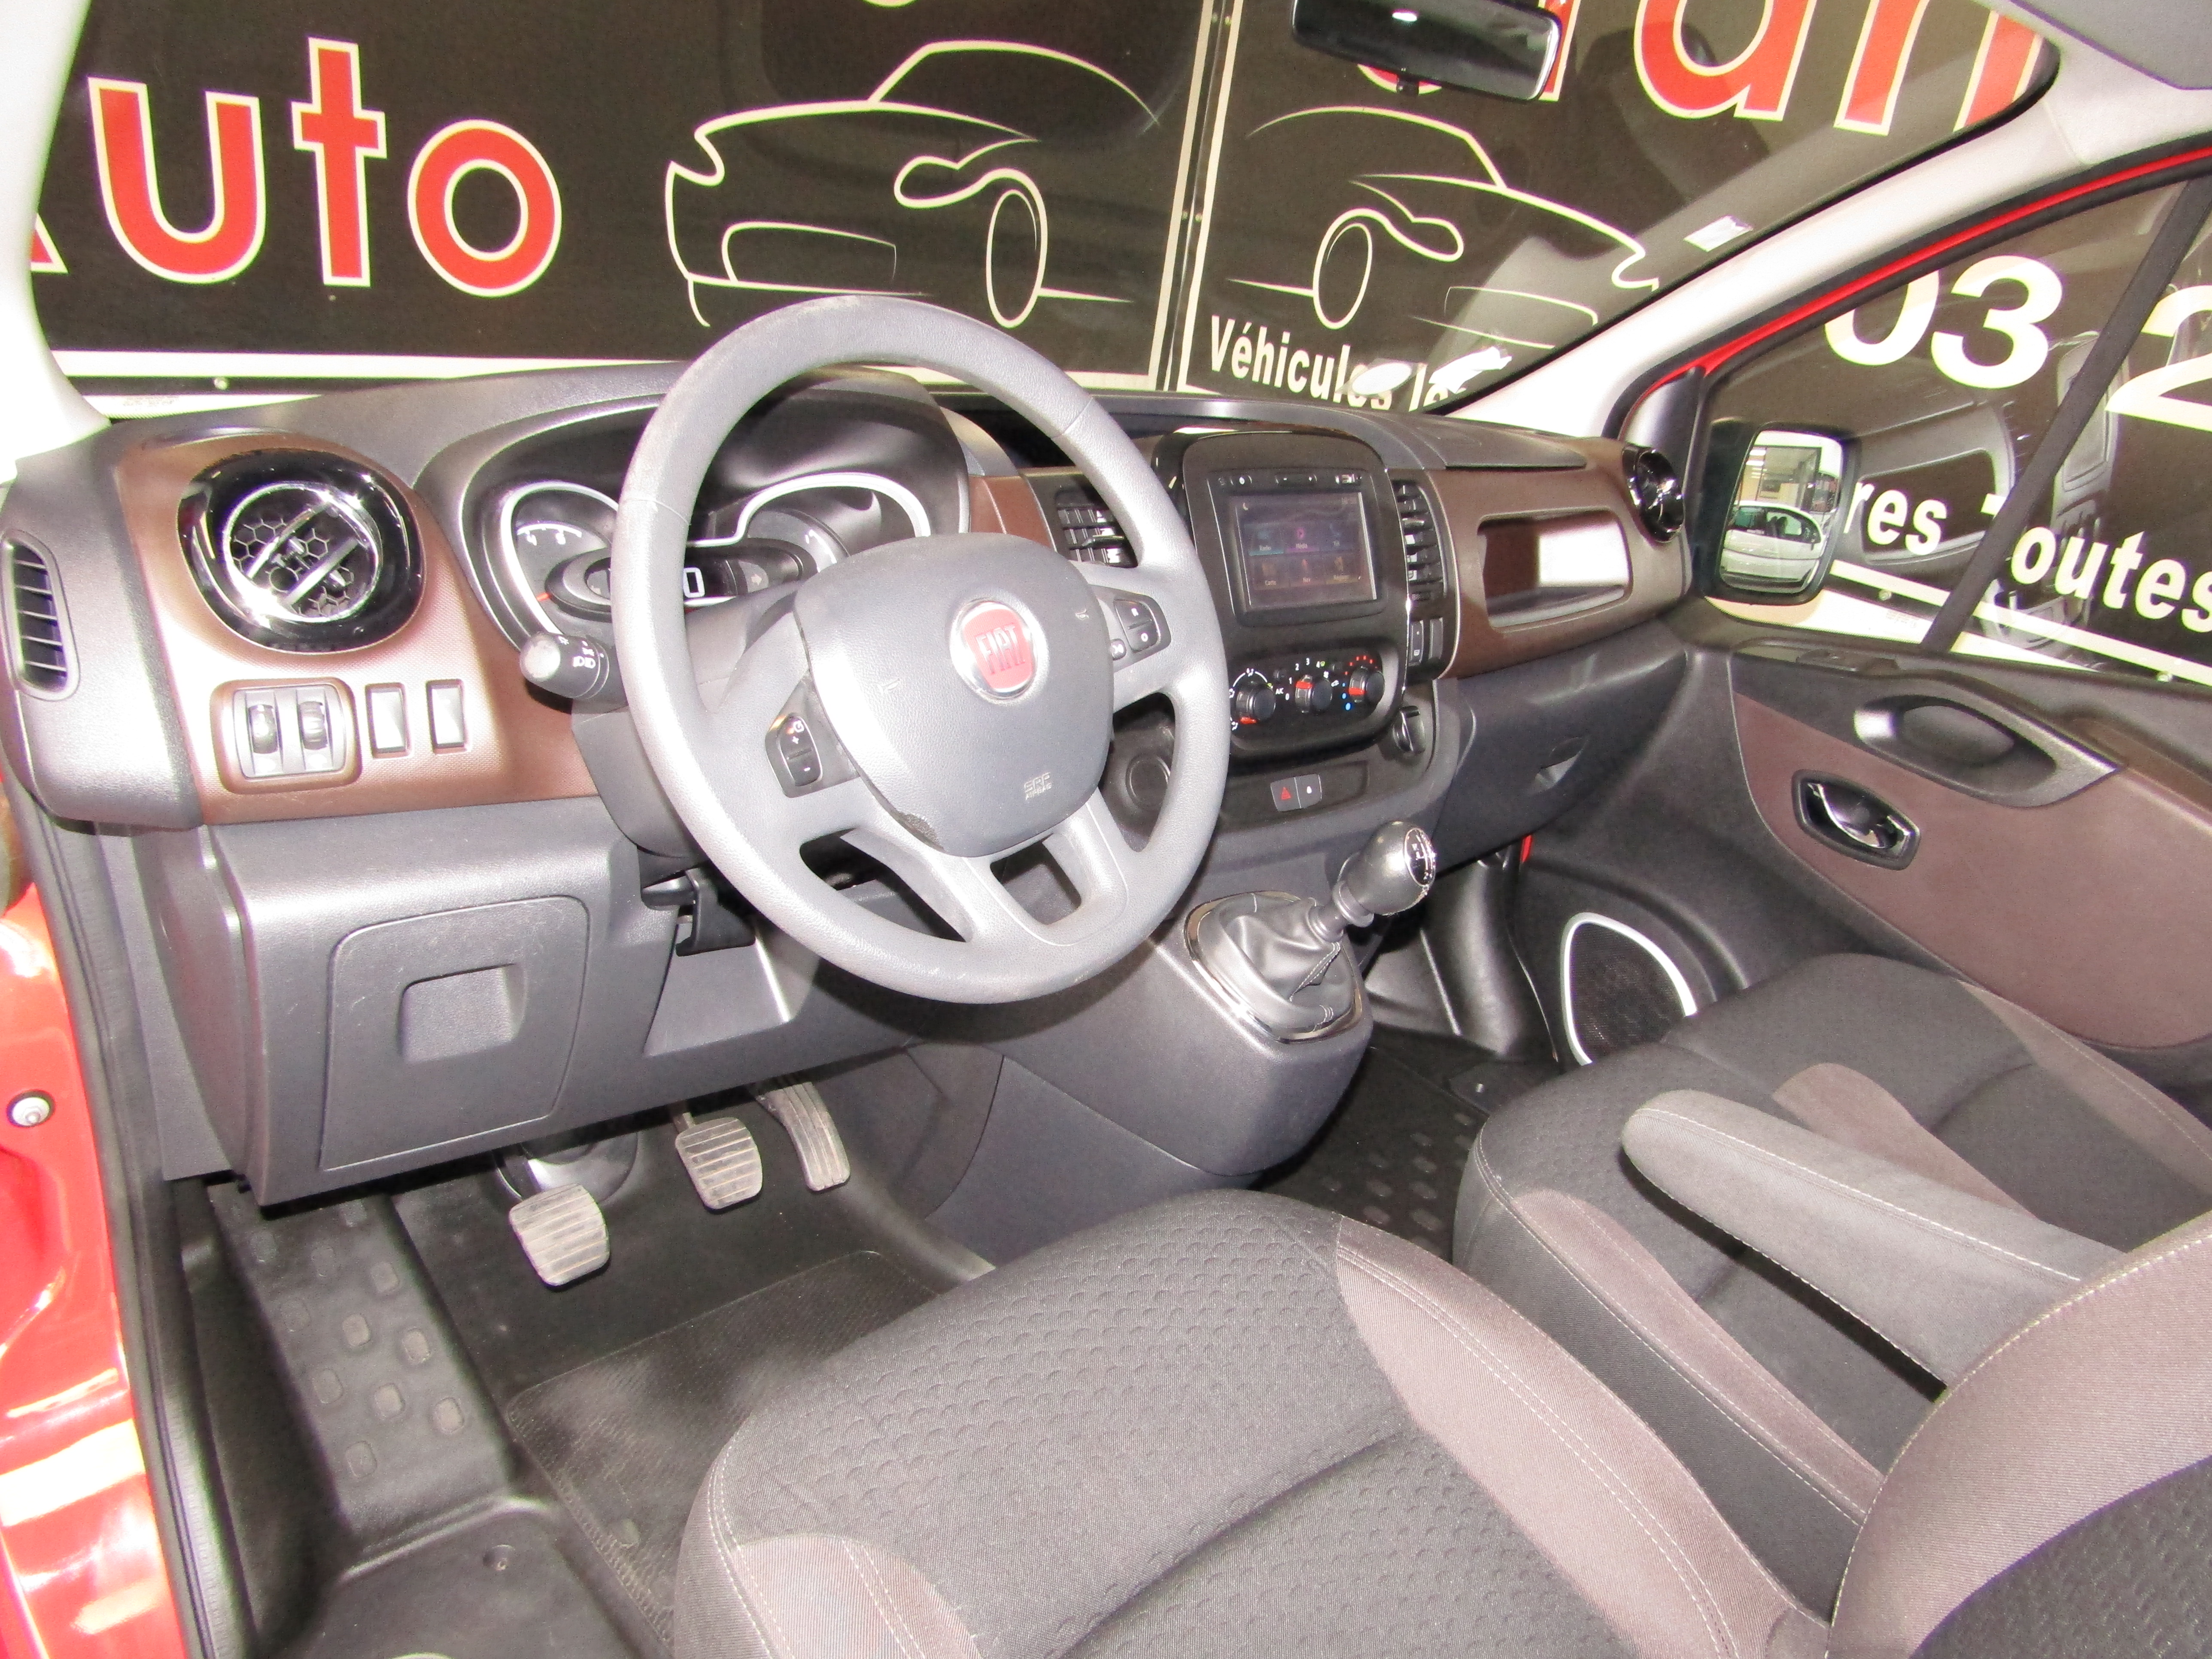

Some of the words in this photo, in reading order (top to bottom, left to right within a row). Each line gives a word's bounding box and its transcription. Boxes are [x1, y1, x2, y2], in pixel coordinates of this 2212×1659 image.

[31, 36, 562, 298] uto
[1824, 255, 2063, 389] 03
[1981, 493, 2212, 633] outes
[975, 625, 1025, 675] FIAT
[1306, 657, 1310, 665] 3
